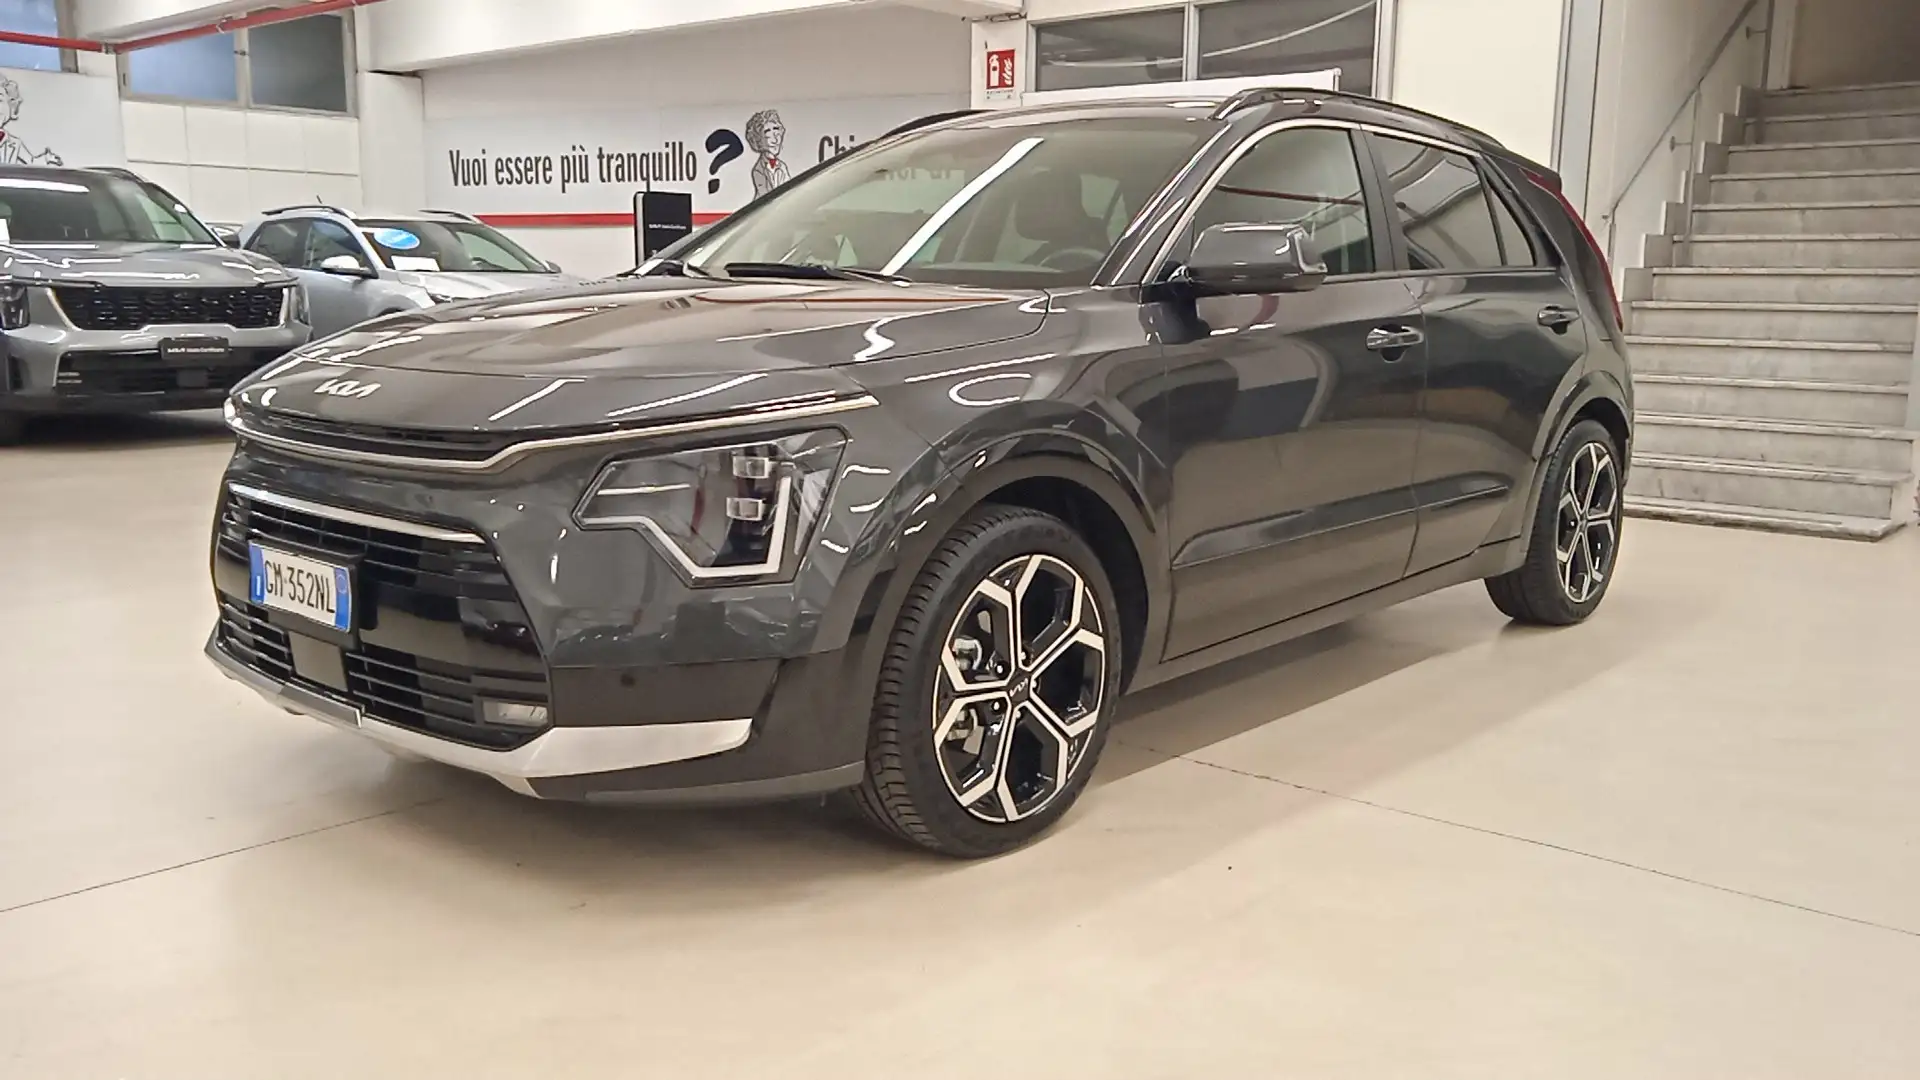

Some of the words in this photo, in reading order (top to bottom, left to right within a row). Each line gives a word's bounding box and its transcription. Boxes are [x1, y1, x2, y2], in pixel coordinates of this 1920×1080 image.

[449, 148, 488, 187] Vuoi
[495, 155, 553, 186] essere
[560, 144, 590, 194] più
[597, 141, 697, 193] tranquillo
[313, 378, 382, 399] KIA
